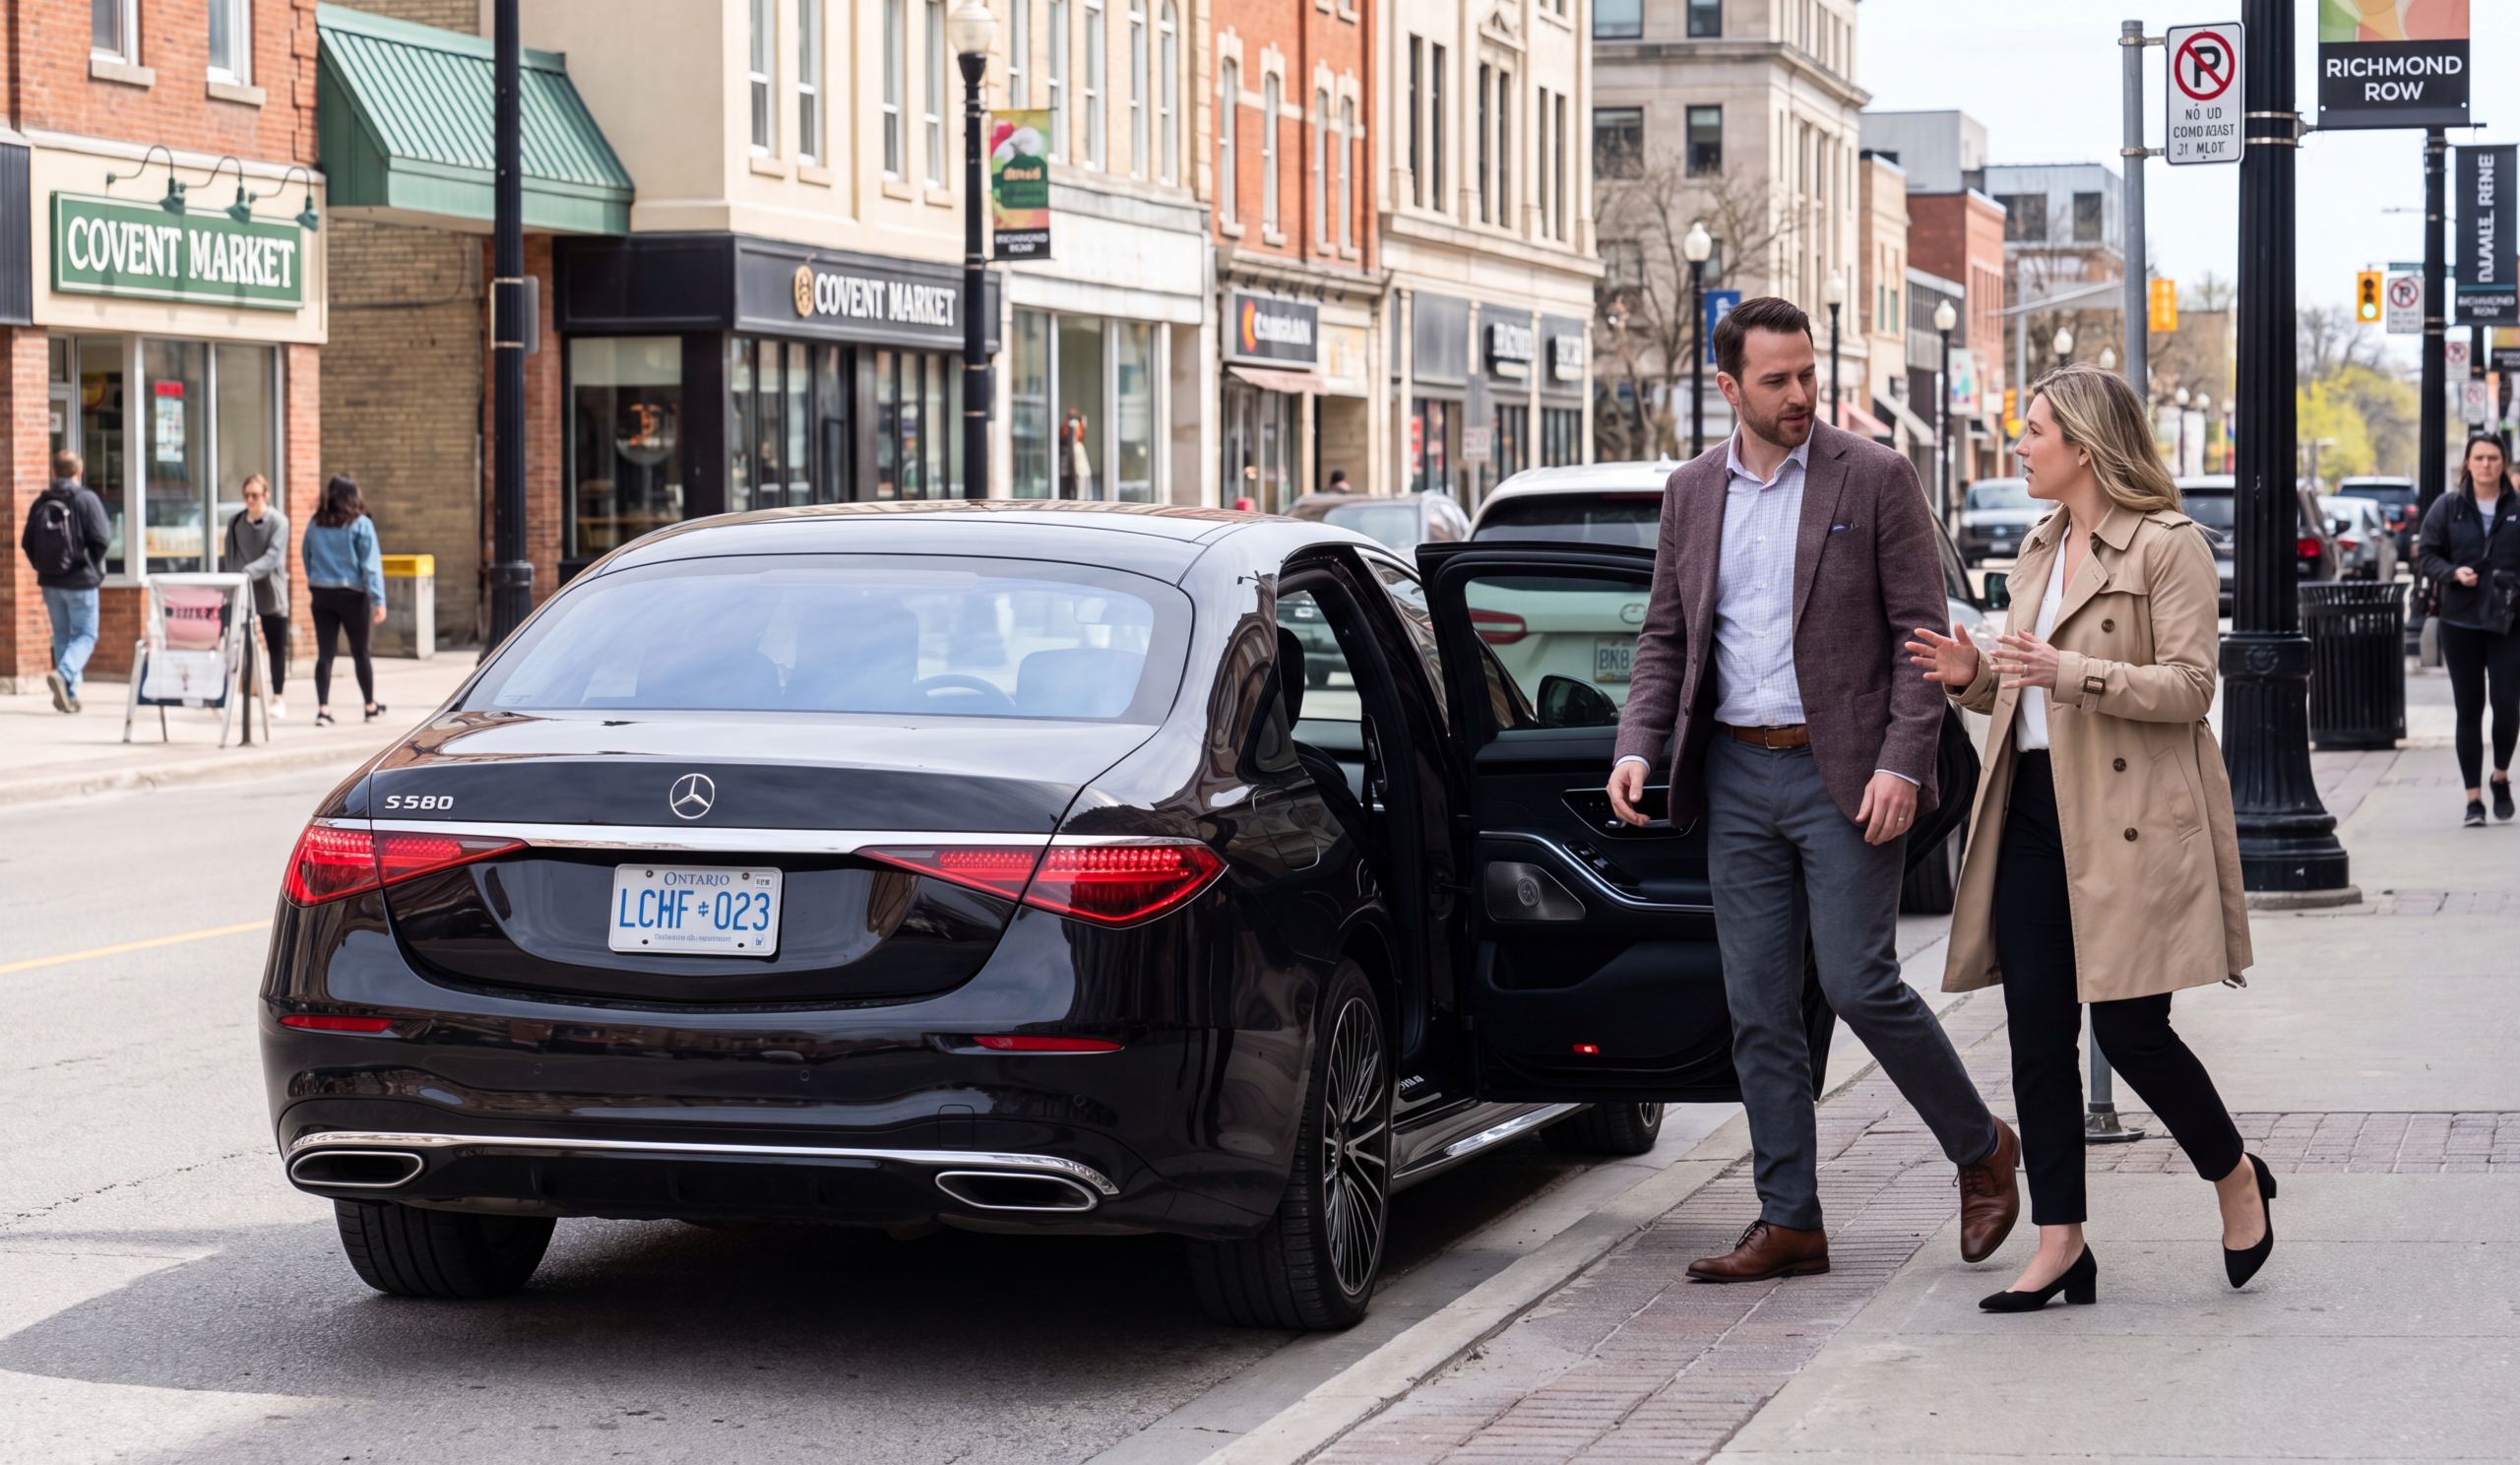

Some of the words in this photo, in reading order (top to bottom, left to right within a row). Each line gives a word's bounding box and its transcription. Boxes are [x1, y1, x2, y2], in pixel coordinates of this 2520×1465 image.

[2326, 56, 2463, 78] RICHMOND
[2364, 81, 2425, 101] ROW
[67, 216, 183, 279] COVENT
[188, 228, 296, 288] MARKET
[815, 273, 885, 319] COVENT
[888, 282, 956, 327] MARKET
